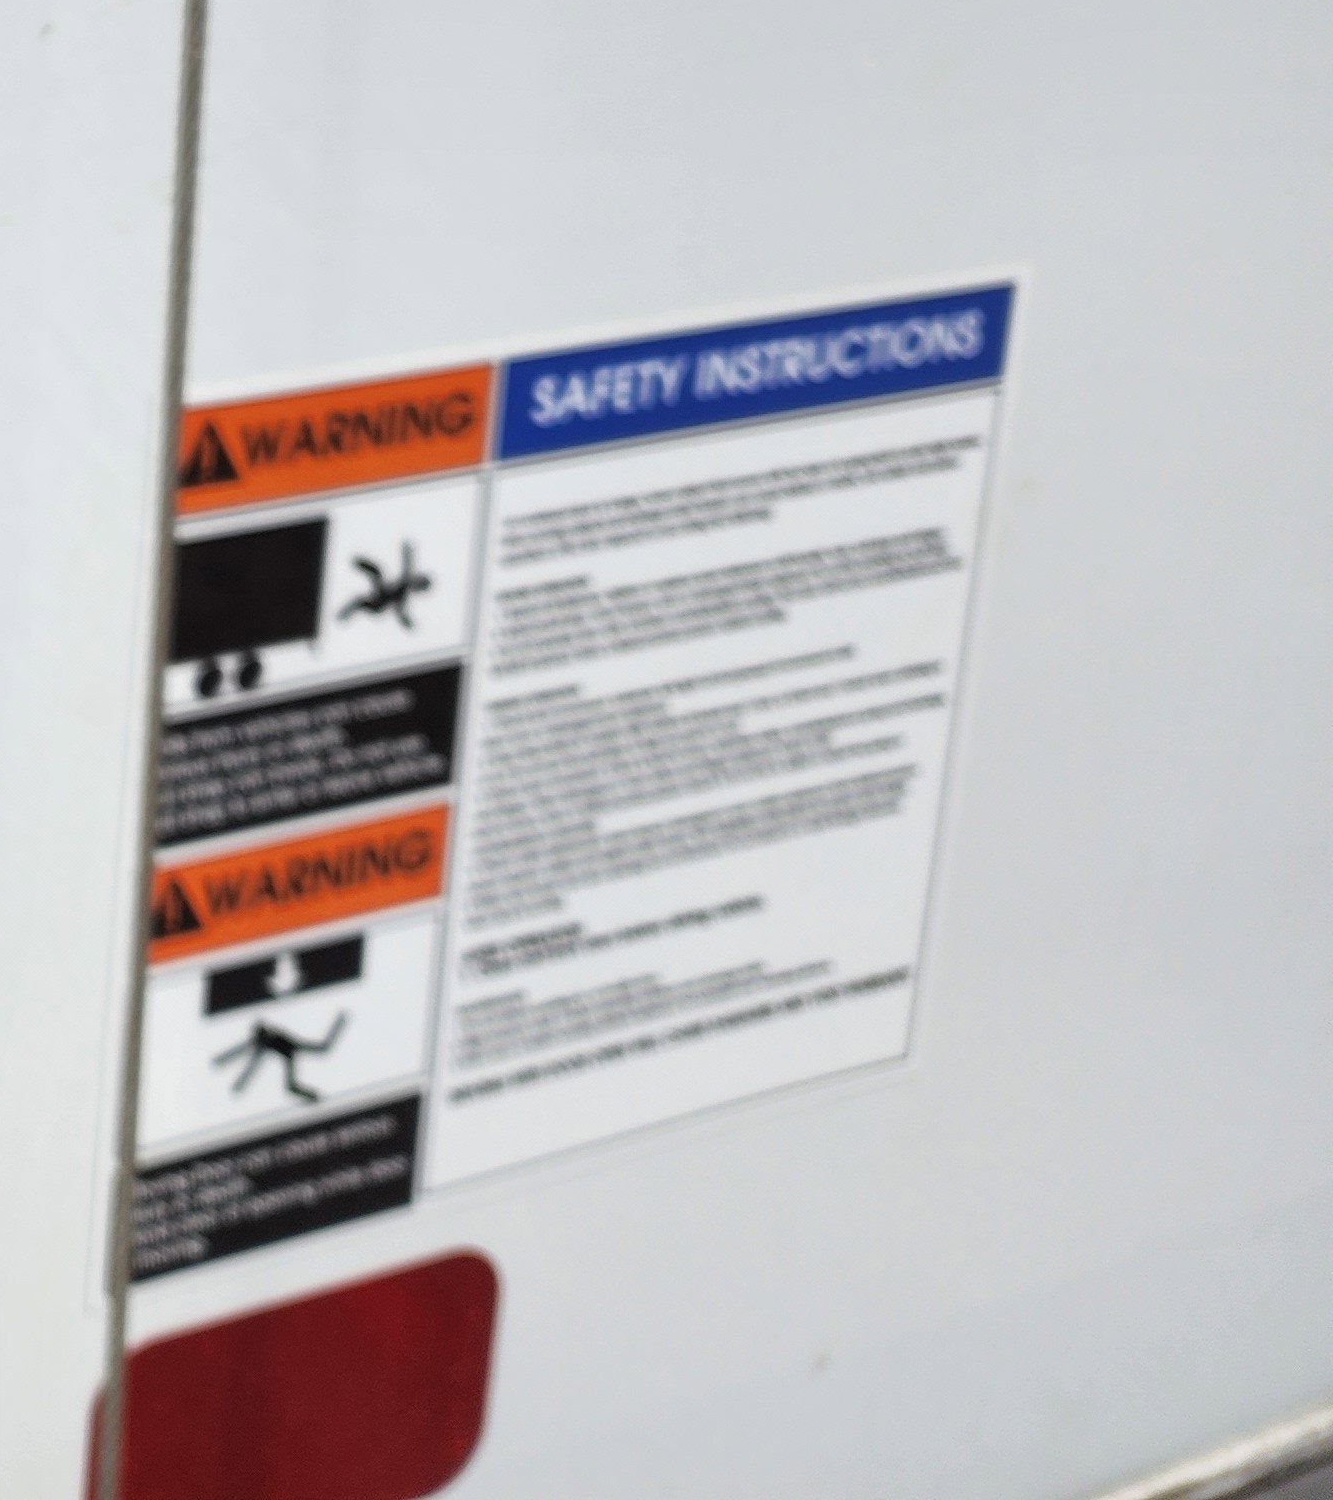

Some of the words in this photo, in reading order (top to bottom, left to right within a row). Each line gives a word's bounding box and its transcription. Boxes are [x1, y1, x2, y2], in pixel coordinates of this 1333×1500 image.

[529, 353, 687, 428] SAFETY
[691, 305, 985, 400] INSTRUCTIONS
[239, 387, 476, 469] WARNING
[203, 825, 433, 918] WARNING
